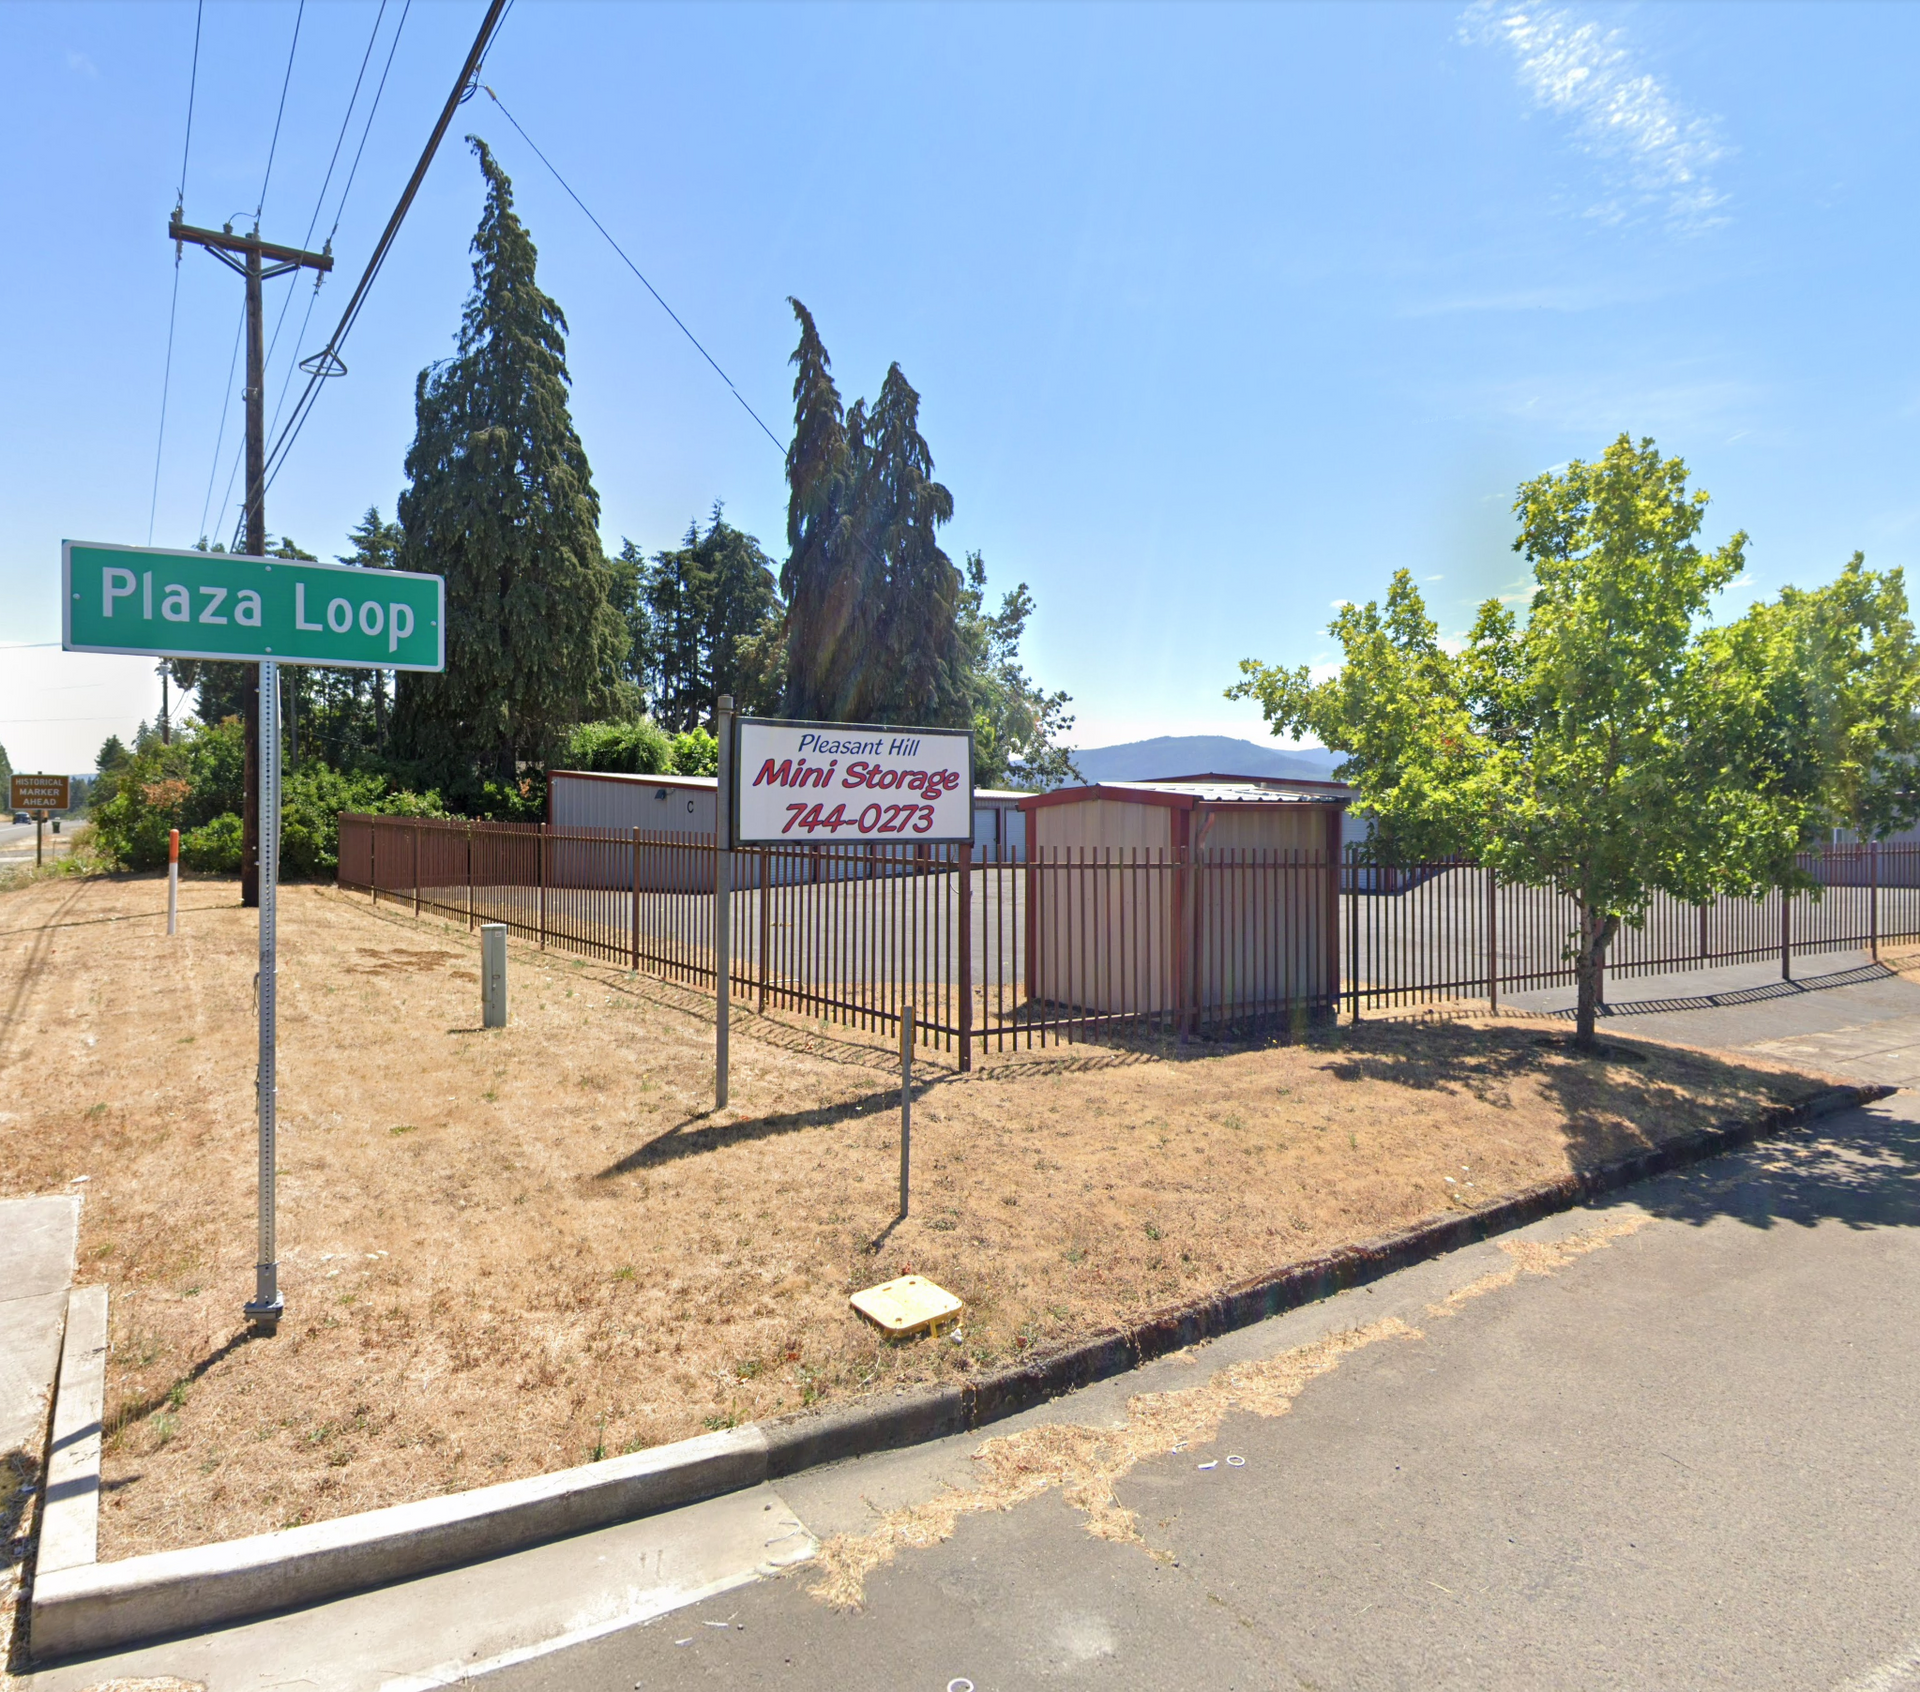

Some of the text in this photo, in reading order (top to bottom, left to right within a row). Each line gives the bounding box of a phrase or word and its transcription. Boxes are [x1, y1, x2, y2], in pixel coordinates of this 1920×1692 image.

[102, 566, 415, 653] Plaza Loop
[798, 733, 920, 757] Pleasant Hill
[15, 778, 64, 786] HISTORICAL
[752, 758, 960, 800] Mini Storage
[19, 788, 60, 796] MARKER
[22, 798, 57, 806] AHEAD
[686, 800, 694, 814] C
[781, 803, 935, 834] 744-0273
